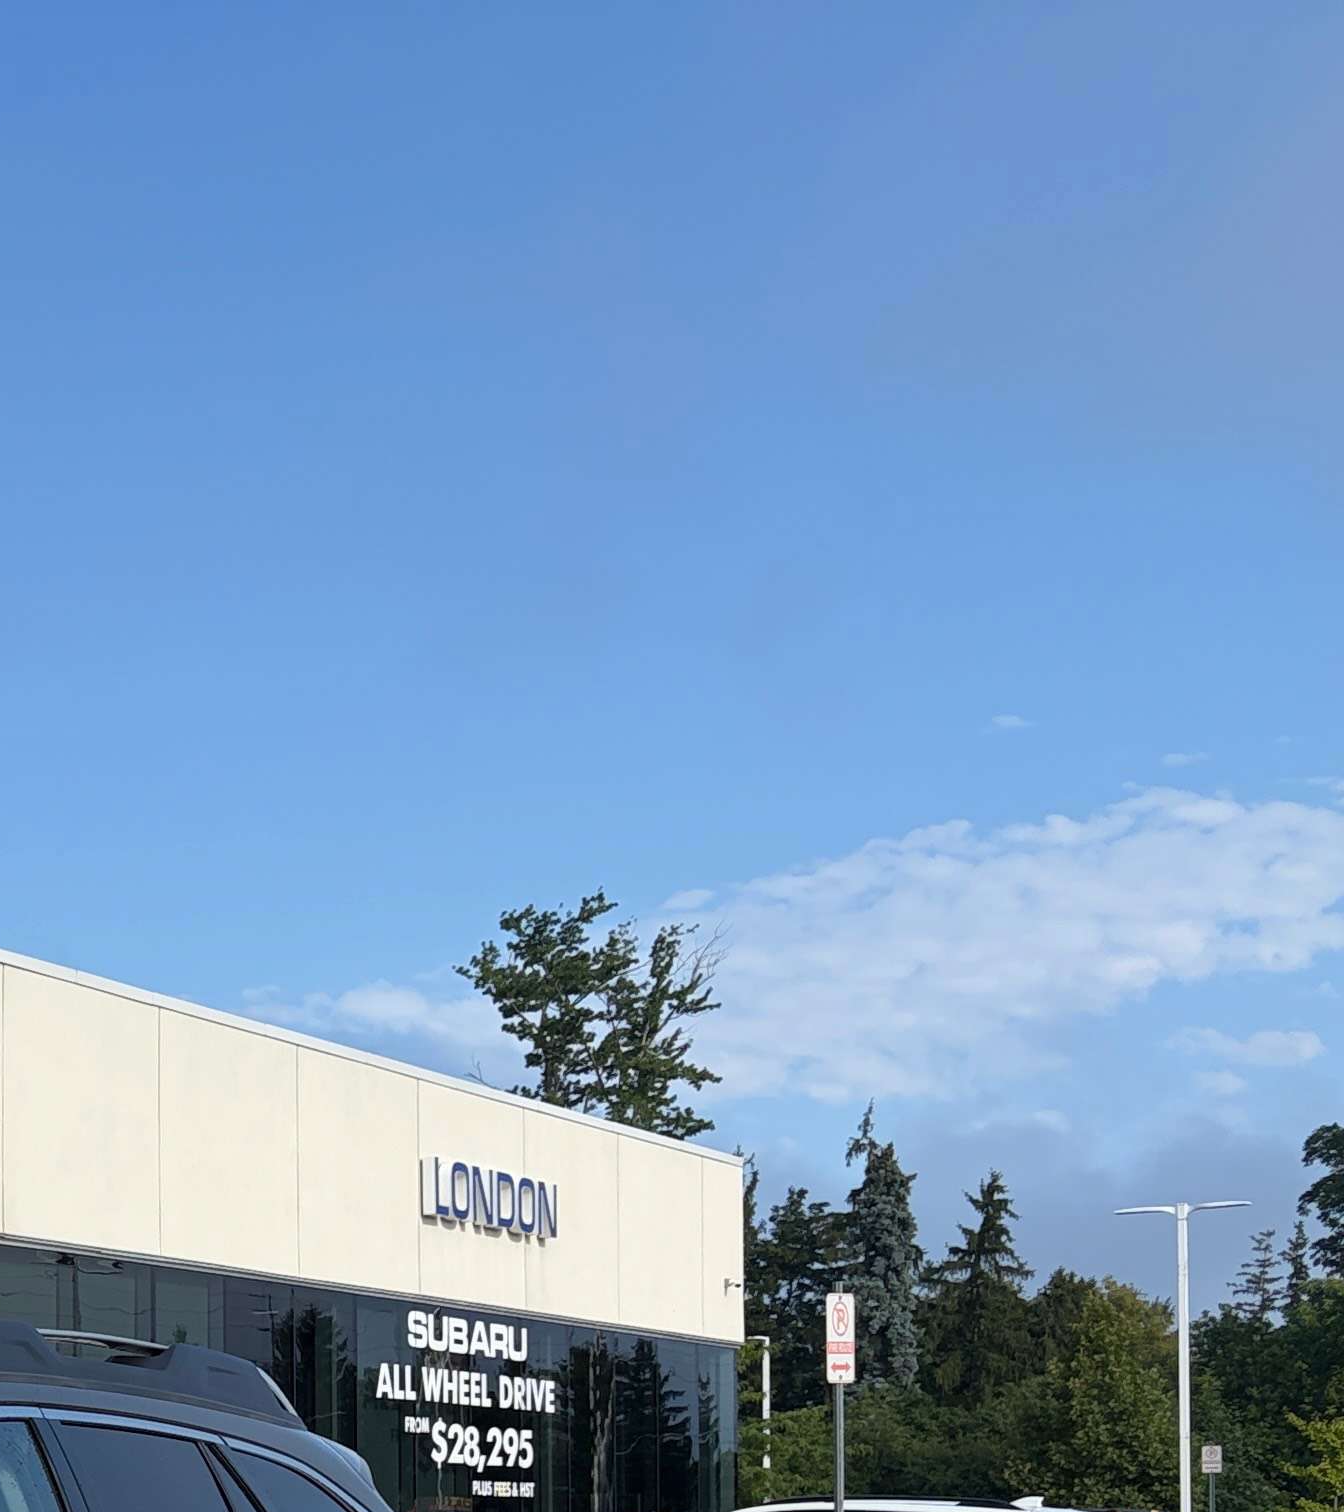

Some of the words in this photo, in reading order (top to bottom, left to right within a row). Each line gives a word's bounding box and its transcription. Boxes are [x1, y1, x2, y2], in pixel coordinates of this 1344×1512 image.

[421, 1157, 558, 1238] LONDON
[407, 1310, 528, 1362] SUBARU
[375, 1362, 417, 1400] ALL
[421, 1365, 492, 1408] WHEEL
[498, 1374, 556, 1414] DRIVE
[404, 1415, 430, 1433] FROM
[430, 1417, 534, 1472] $28,295
[472, 1480, 493, 1497] PLUS
[494, 1481, 511, 1497] FEES
[519, 1482, 535, 1498] HST
